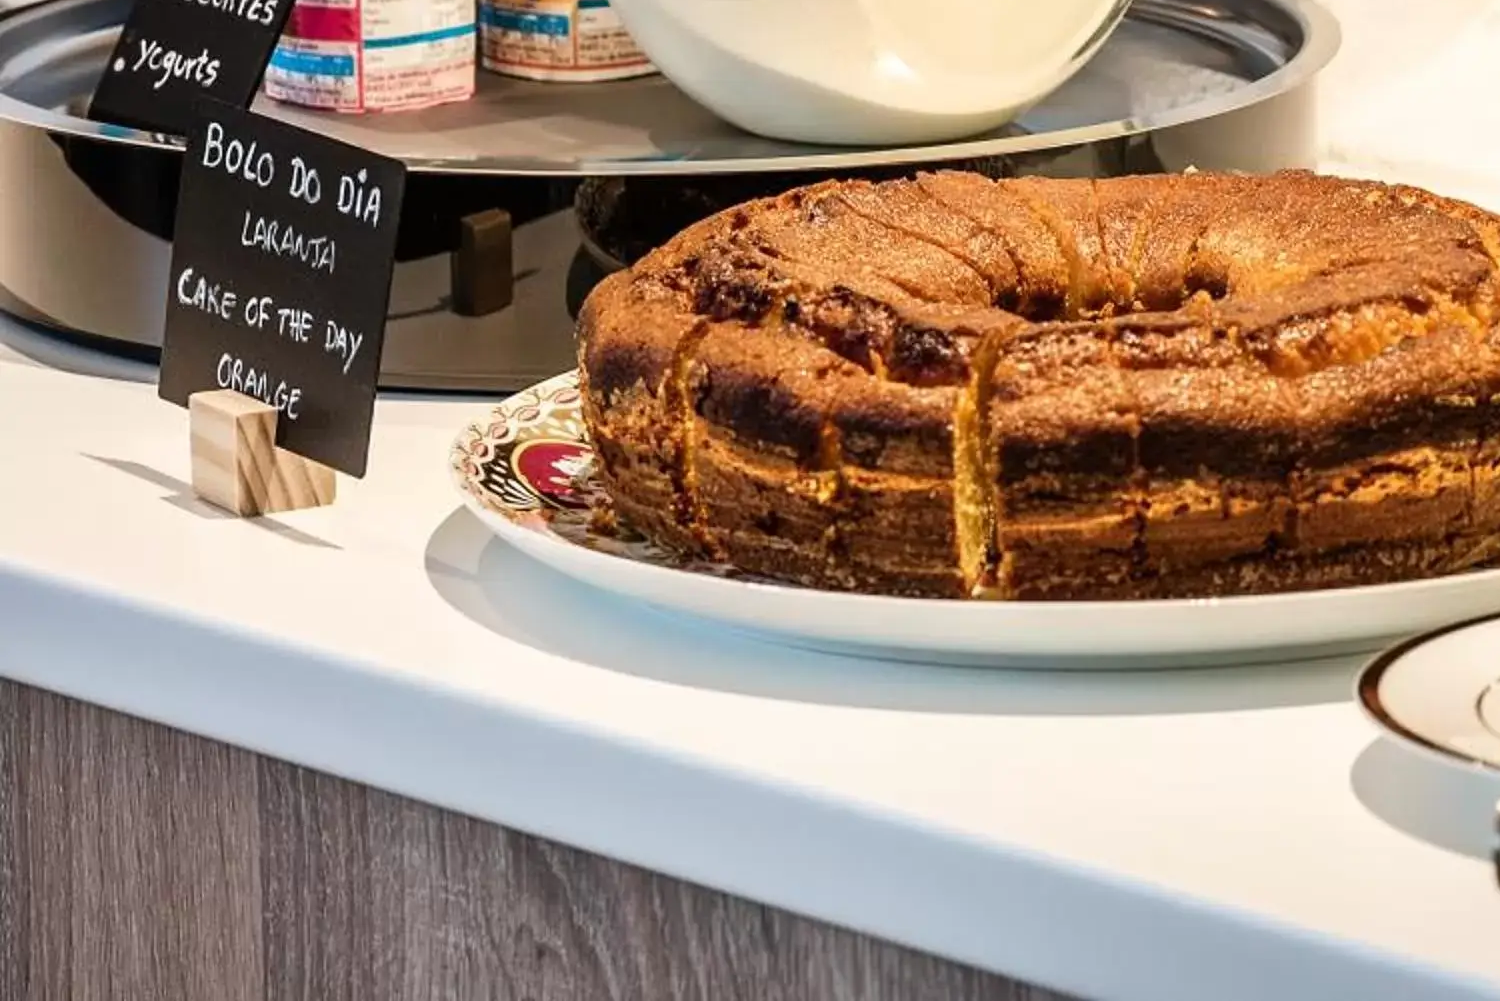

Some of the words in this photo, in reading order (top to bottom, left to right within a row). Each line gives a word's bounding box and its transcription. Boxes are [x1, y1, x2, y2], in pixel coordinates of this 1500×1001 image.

[203, 122, 273, 187] BOLO
[289, 157, 321, 204] DO
[241, 211, 335, 274] LARANJA
[177, 268, 237, 319] CAKE
[245, 297, 272, 328] OF
[278, 309, 312, 342] THE
[325, 321, 363, 373] DAY
[217, 353, 302, 420] ORANGE
